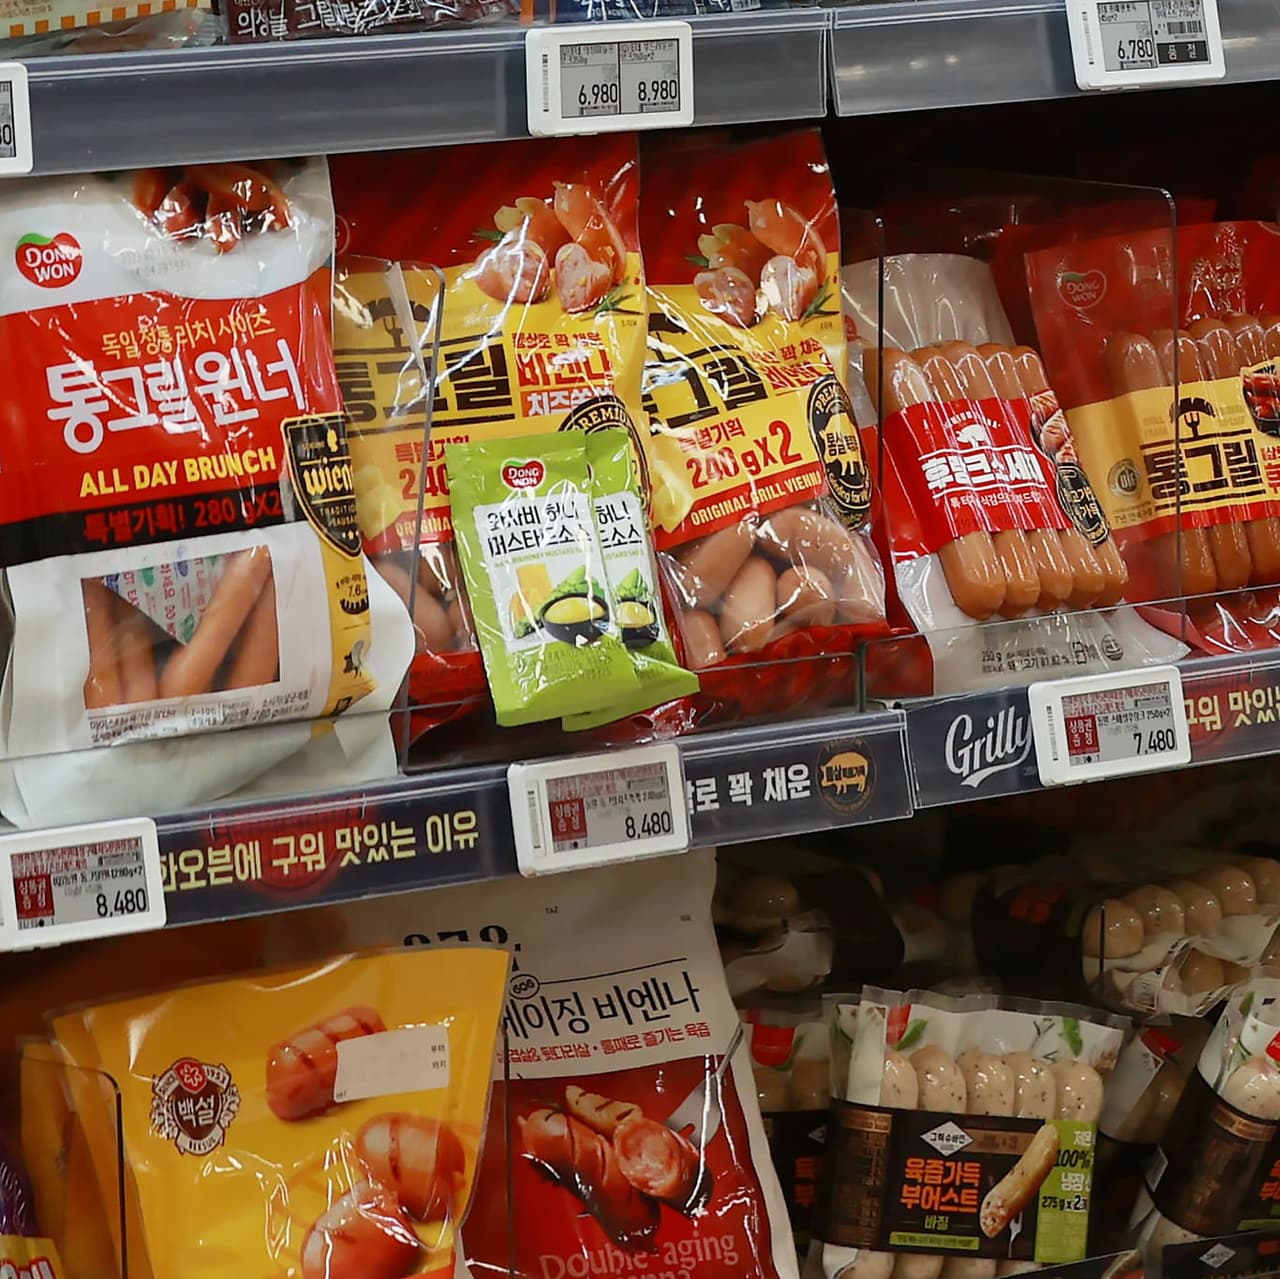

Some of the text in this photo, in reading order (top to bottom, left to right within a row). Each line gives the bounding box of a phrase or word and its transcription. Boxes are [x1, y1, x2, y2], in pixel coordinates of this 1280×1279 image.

[25, 246, 81, 269] DONG
[34, 261, 75, 282] WON
[1065, 279, 1101, 295] DONG
[1072, 291, 1098, 305] WON
[102, 333, 137, 359] 독일
[177, 321, 216, 350] 리치
[219, 308, 275, 341] 사이즈
[80, 445, 277, 498] ALL DAY BRUNCH
[508, 467, 540, 479] DONG
[512, 476, 538, 487] WON
[1144, 438, 1264, 501] 통그릴
[83, 501, 187, 543] 특별기획!
[194, 496, 237, 528] 280
[691, 491, 750, 526] ORIGINAL
[395, 516, 452, 537] ORIGINA
[945, 706, 1032, 789] Grilly
[728, 772, 754, 807] 꽉
[763, 762, 812, 803] 채운
[160, 843, 263, 893] 화오븐에
[272, 833, 326, 875] 구워
[335, 820, 417, 863] 맛있는
[425, 809, 479, 850] 이유
[593, 970, 702, 1026] 비엔나
[643, 1026, 685, 1048] 즐기는
[177, 1096, 216, 1129] 백설
[904, 1156, 982, 1188] 육즙가득
[900, 1184, 980, 1215] 부어스트
